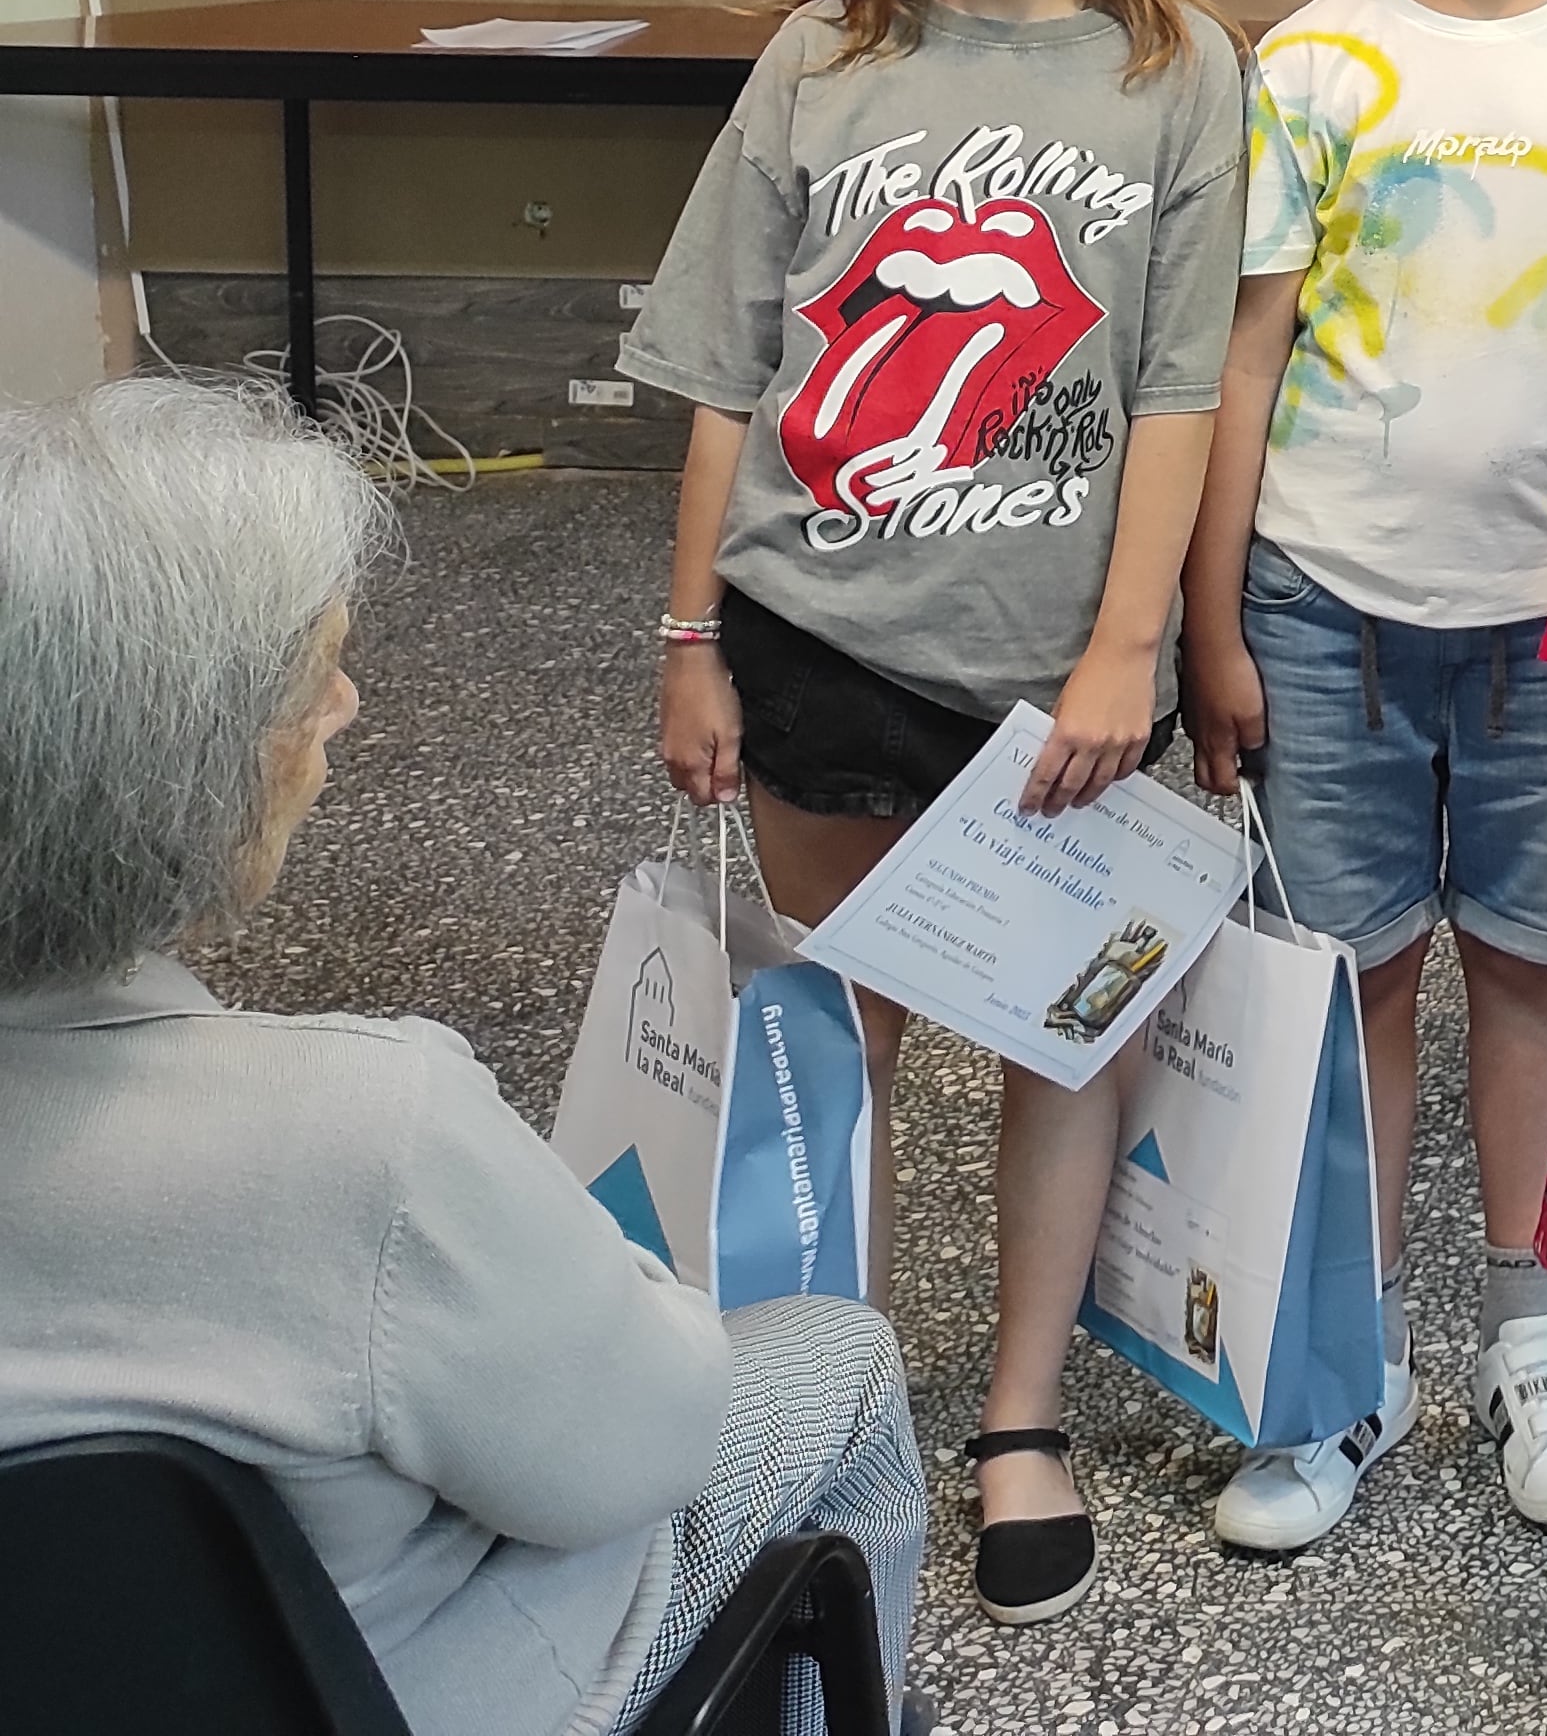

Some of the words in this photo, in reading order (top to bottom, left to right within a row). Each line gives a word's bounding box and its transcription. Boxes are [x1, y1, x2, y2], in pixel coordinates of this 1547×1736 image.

[1403, 129, 1533, 180] Morato
[809, 129, 928, 236] The
[931, 124, 1153, 246] Rolling
[1054, 368, 1102, 426] only
[803, 436, 1089, 552] Stones
[993, 797, 1033, 833] Cosas
[1035, 823, 1055, 844] de
[1054, 835, 1113, 877] Abuelos
[1116, 812, 1130, 826] de
[989, 839, 1026, 866] viaje
[640, 1020, 680, 1061] Santa
[682, 1043, 722, 1088] María
[1153, 1036, 1165, 1061] la
[1167, 1045, 1196, 1081] Real
[1157, 1009, 1191, 1047] Santa
[1193, 1029, 1234, 1068] María
[636, 1048, 649, 1074] la
[652, 1061, 684, 1096] Real
